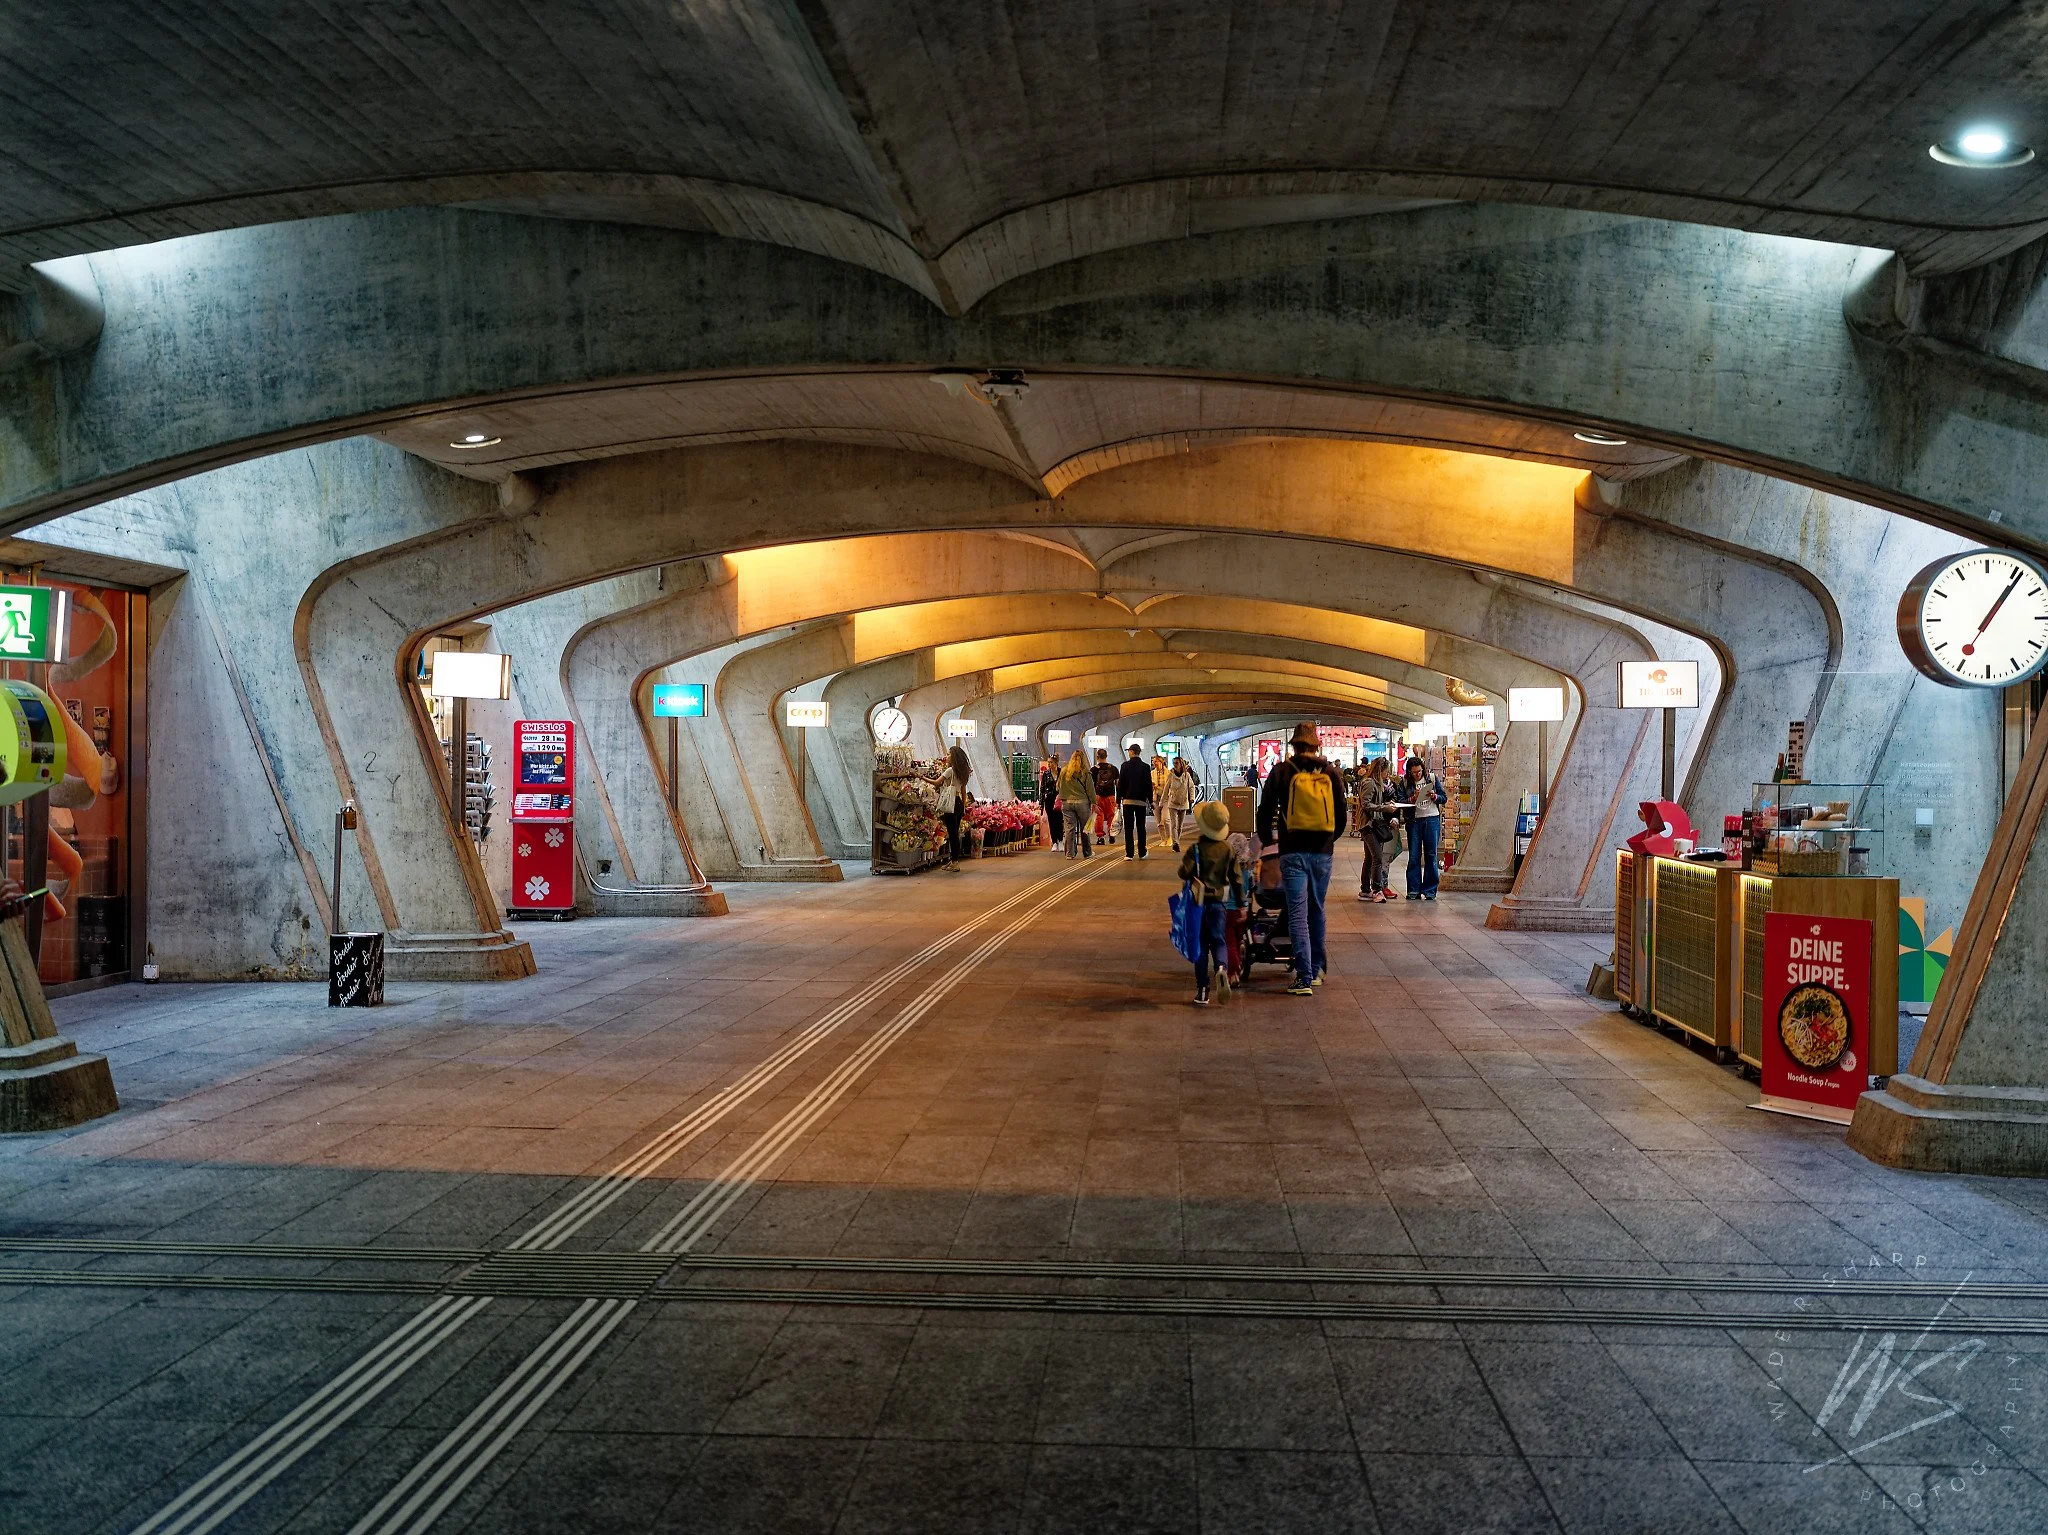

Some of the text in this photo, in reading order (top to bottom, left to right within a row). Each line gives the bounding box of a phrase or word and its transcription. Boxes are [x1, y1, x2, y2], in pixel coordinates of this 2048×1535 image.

[521, 723, 566, 732] SWISSLOS
[363, 750, 379, 773] 2
[1789, 937, 1843, 963] DEINE
[1787, 962, 1850, 990] SUPPE.
[1787, 1072, 1808, 1083] Noodle
[1809, 1076, 1824, 1087] Soup
